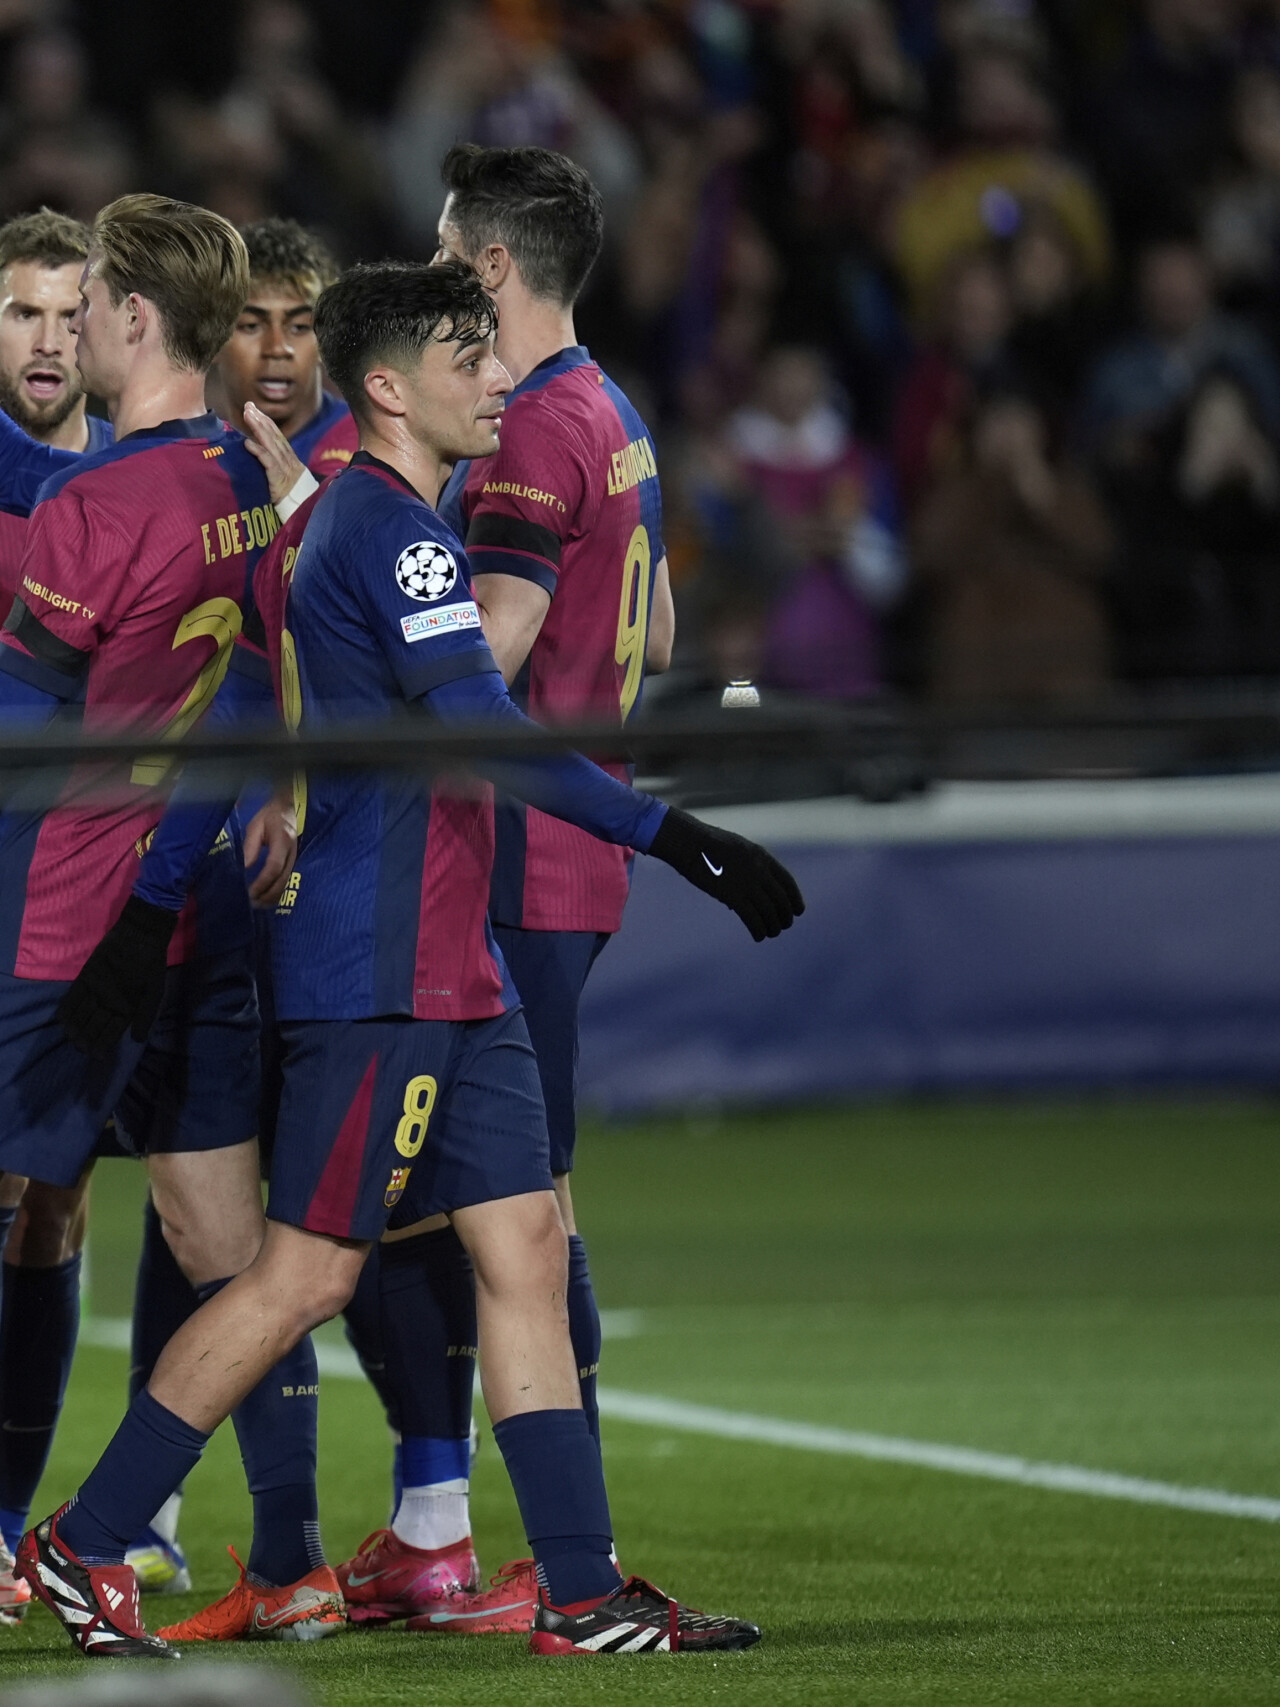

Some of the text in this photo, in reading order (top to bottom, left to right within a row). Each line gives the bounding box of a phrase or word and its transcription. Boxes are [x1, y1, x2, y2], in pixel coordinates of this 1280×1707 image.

[482, 481, 557, 507] AMBILIGHT
[201, 503, 281, 566] F. DE JON
[22, 575, 96, 620] AMBILIGHT tv
[404, 609, 477, 634] FOUNDATION
[614, 524, 651, 730] 9
[394, 1074, 438, 1159] 8
